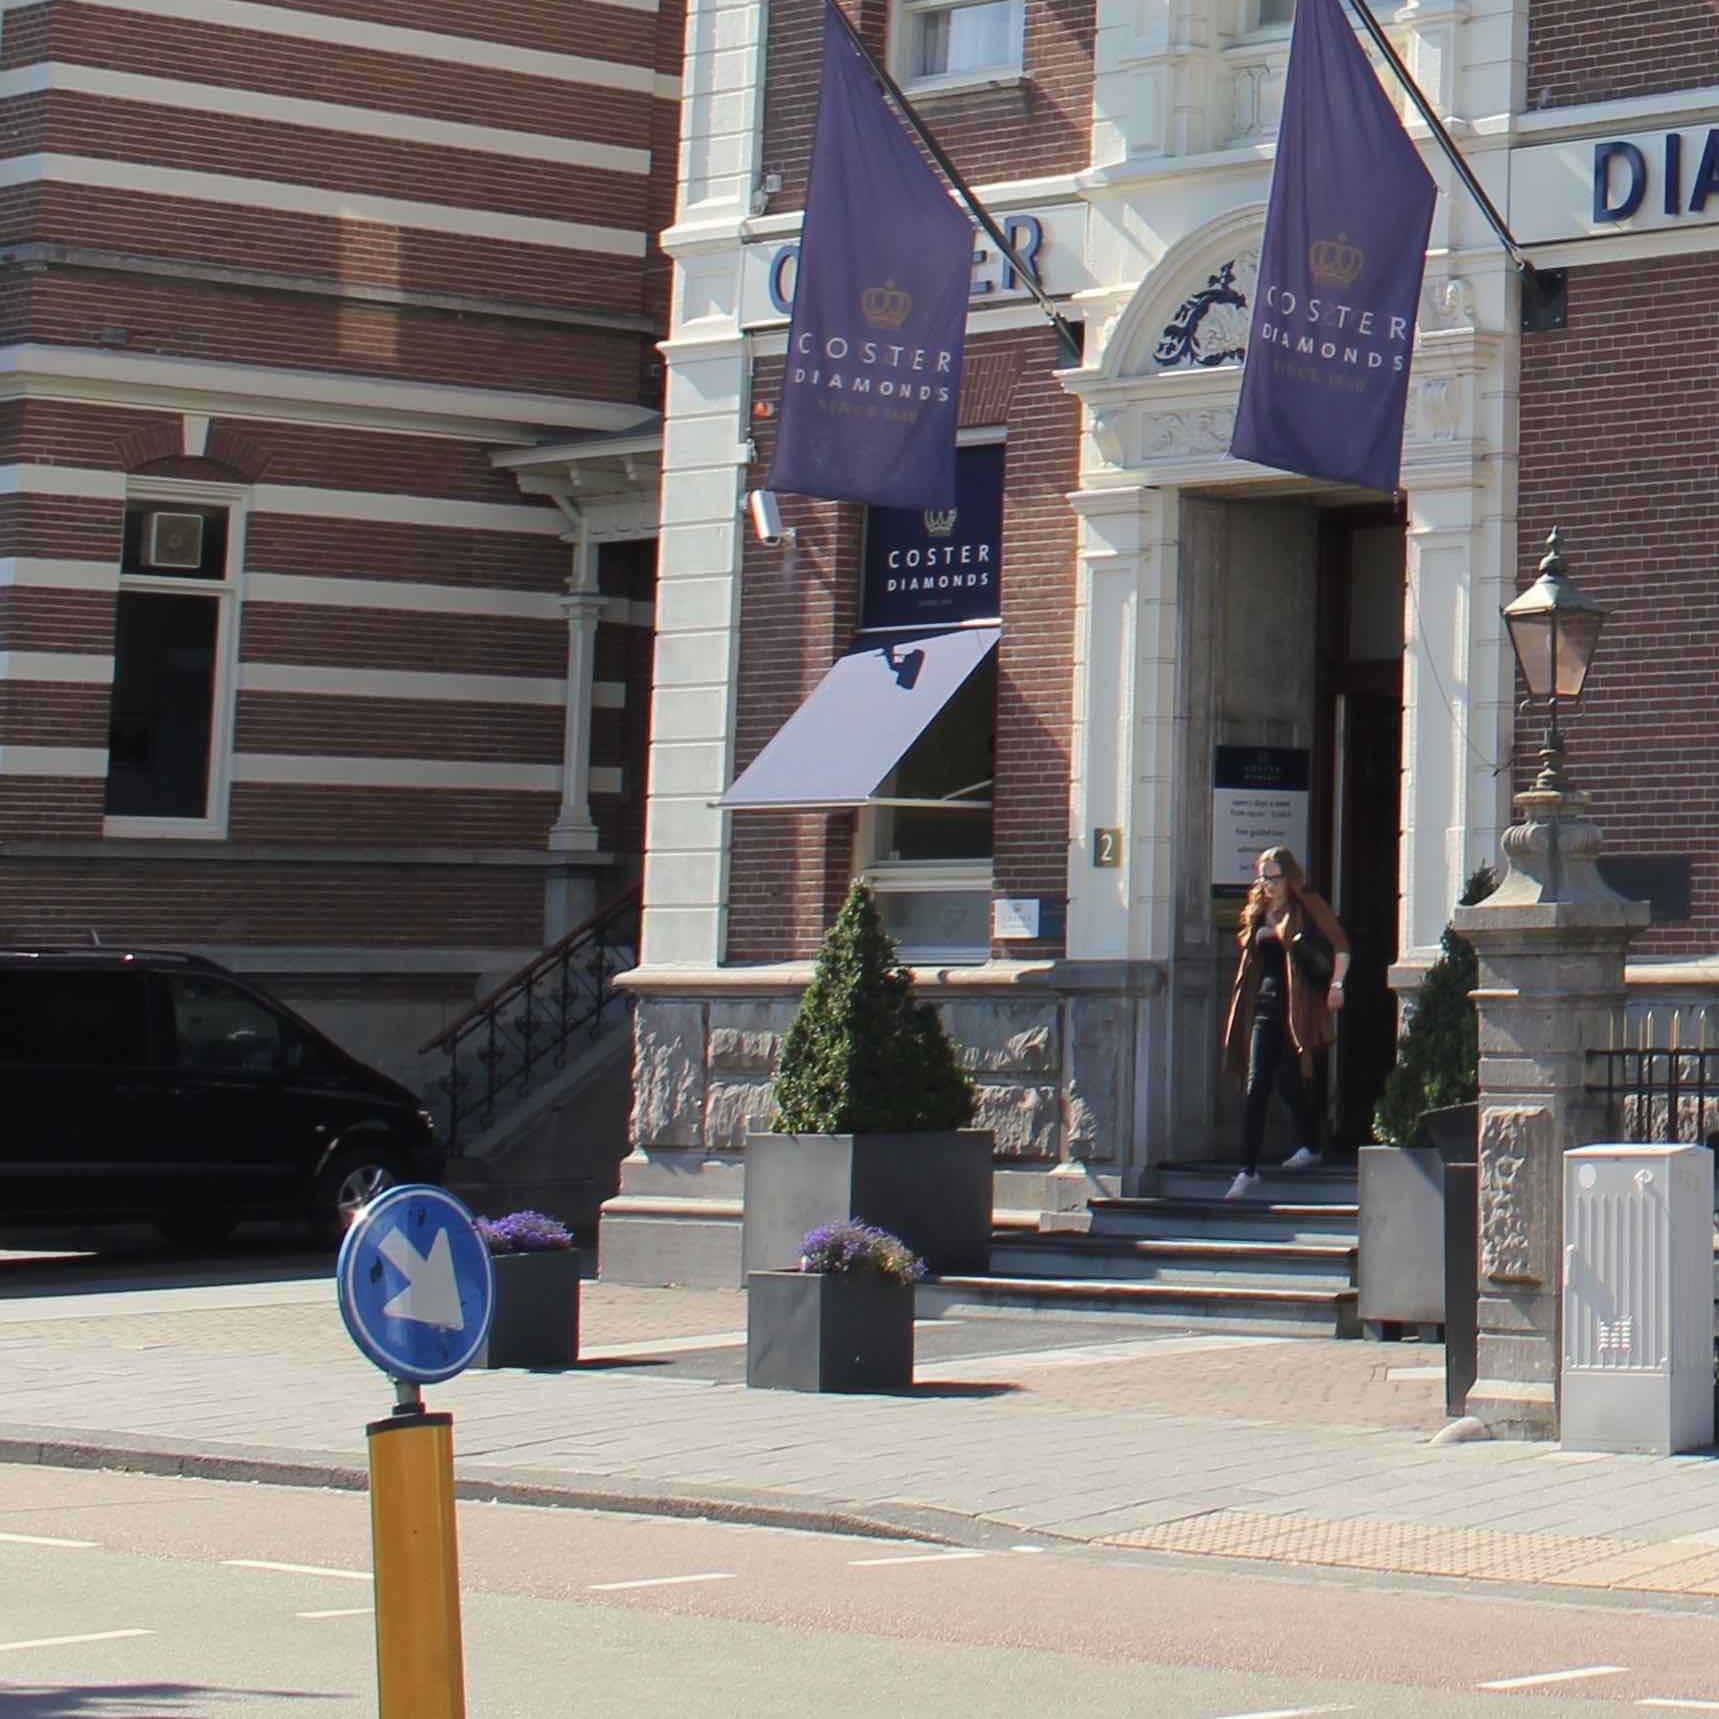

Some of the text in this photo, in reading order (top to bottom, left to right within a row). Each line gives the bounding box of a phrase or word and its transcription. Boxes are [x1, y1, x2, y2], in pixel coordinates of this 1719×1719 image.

[1266, 285, 1409, 341] COSTER
[798, 332, 952, 373] COSTER
[1261, 322, 1404, 371] DIAMONDS
[794, 367, 950, 403] DIAMONDS
[888, 544, 990, 569] COSTER
[887, 572, 989, 592] DIAMONDS
[1100, 833, 1113, 862] 2
